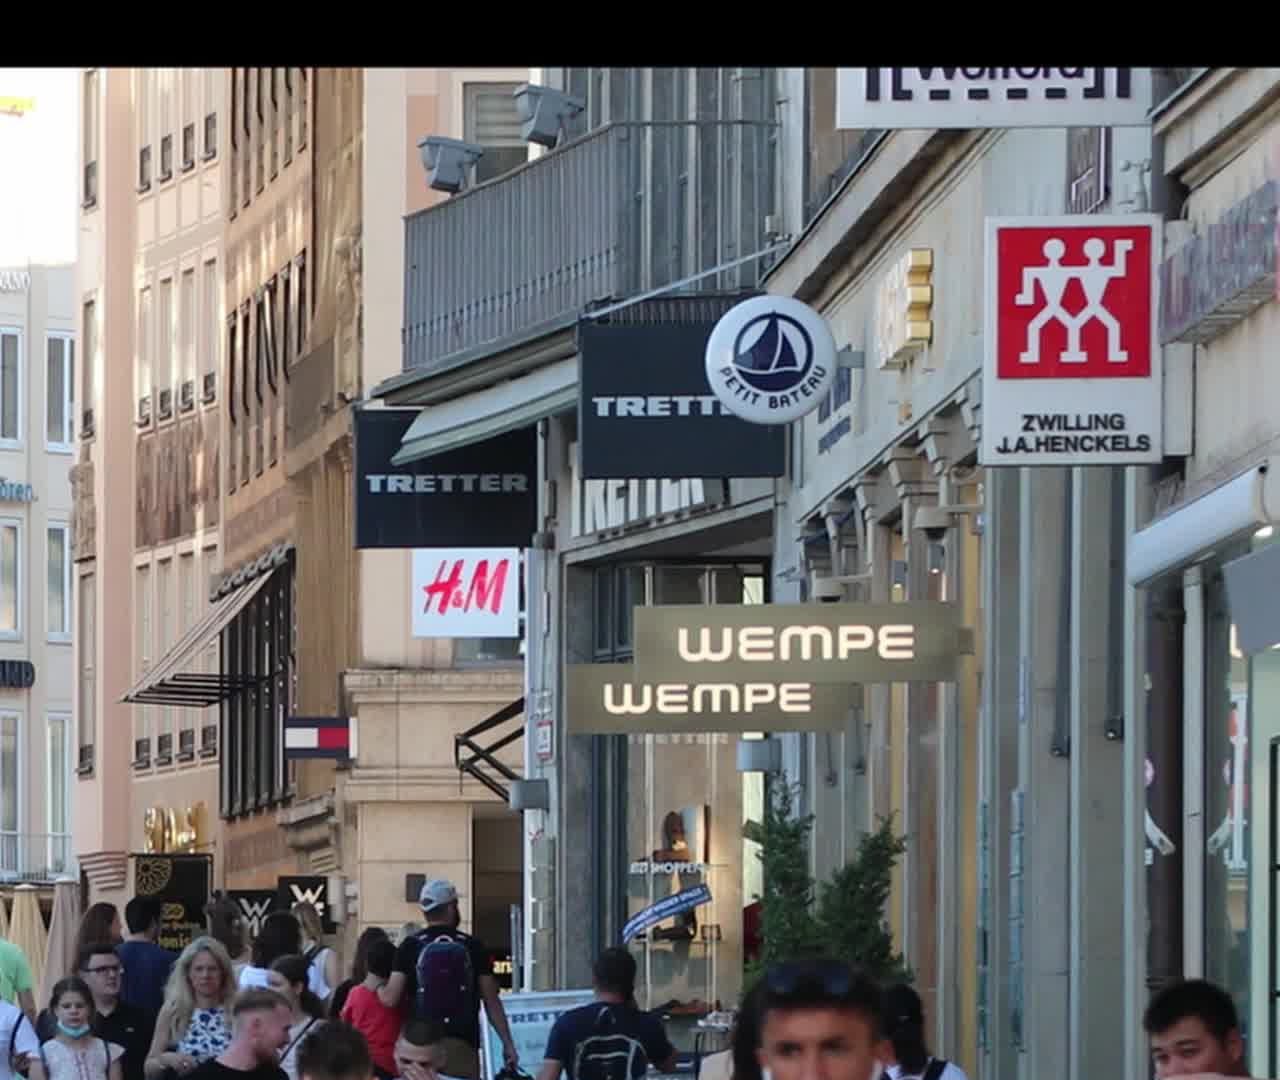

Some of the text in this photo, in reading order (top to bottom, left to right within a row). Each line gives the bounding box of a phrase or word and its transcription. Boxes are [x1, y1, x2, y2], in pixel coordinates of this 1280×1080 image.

[720, 366, 761, 406] PETIT
[768, 365, 828, 409] BATEAU
[592, 395, 741, 417] TRETT
[1022, 413, 1126, 432] ZWILLING
[996, 434, 1151, 453] J.A.HENCKELS
[365, 474, 528, 493] TRETTER
[423, 559, 509, 616] H&M
[677, 624, 915, 662] WEMPE
[604, 682, 812, 714] WEMPE
